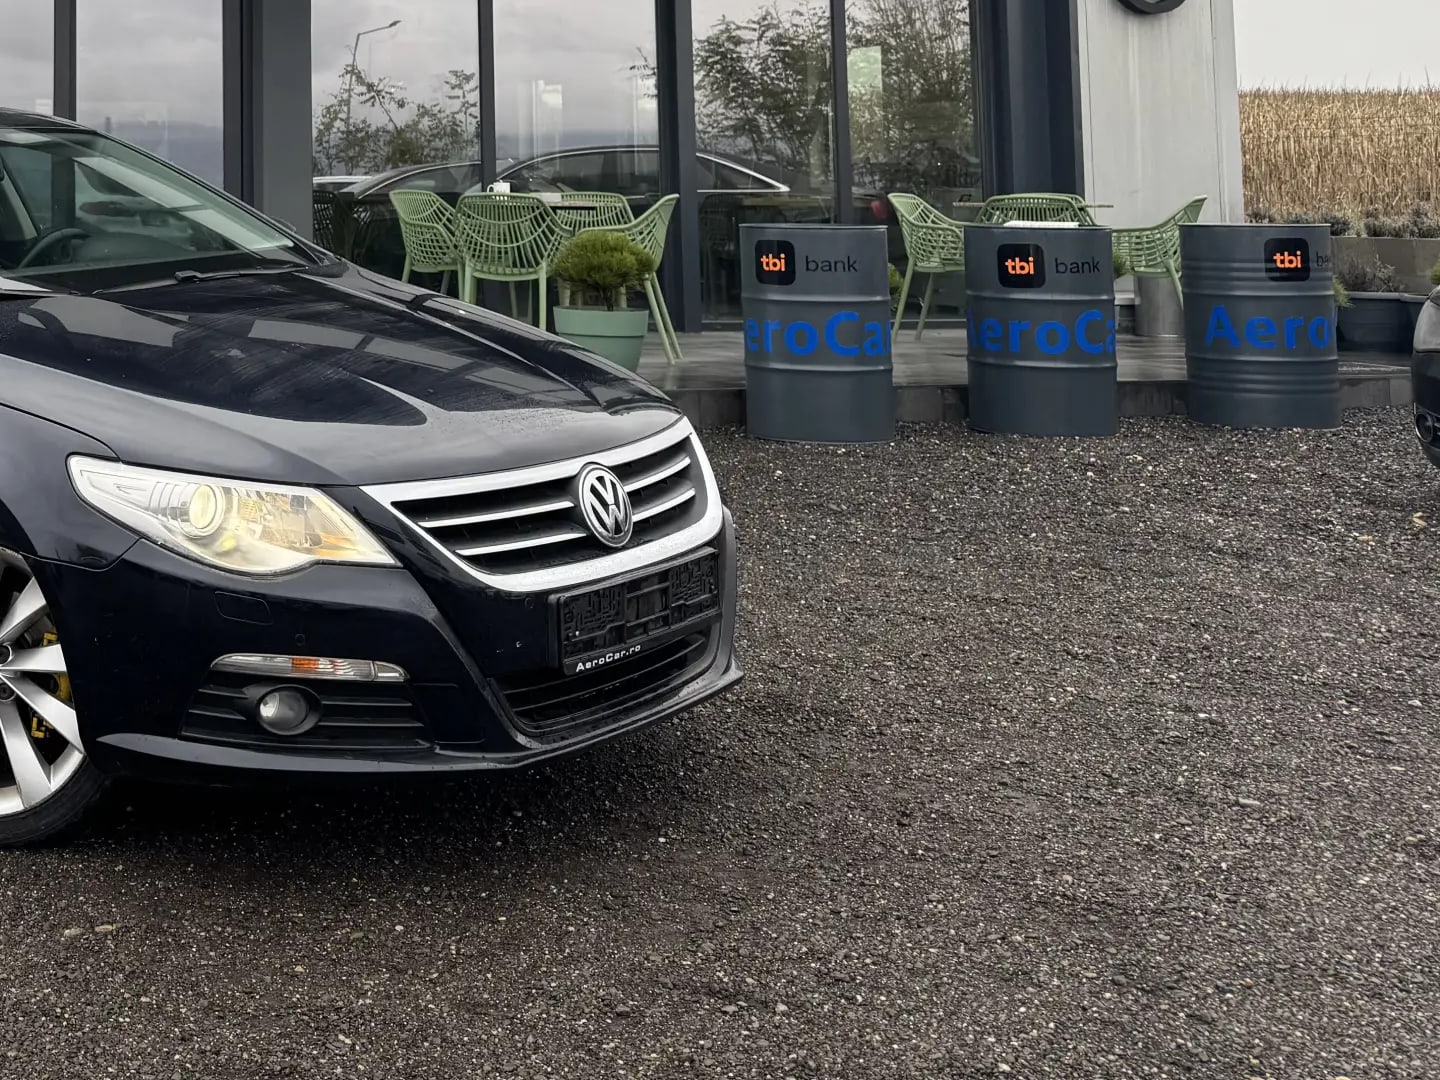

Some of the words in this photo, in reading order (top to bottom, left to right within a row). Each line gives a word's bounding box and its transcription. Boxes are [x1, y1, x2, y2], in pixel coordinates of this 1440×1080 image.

[761, 253, 785, 271] tbi
[805, 255, 858, 272] bank
[1005, 257, 1035, 275] tbi
[1055, 257, 1101, 274] bank
[1273, 250, 1302, 269] tbi
[575, 644, 641, 673] AeroCar.ro
